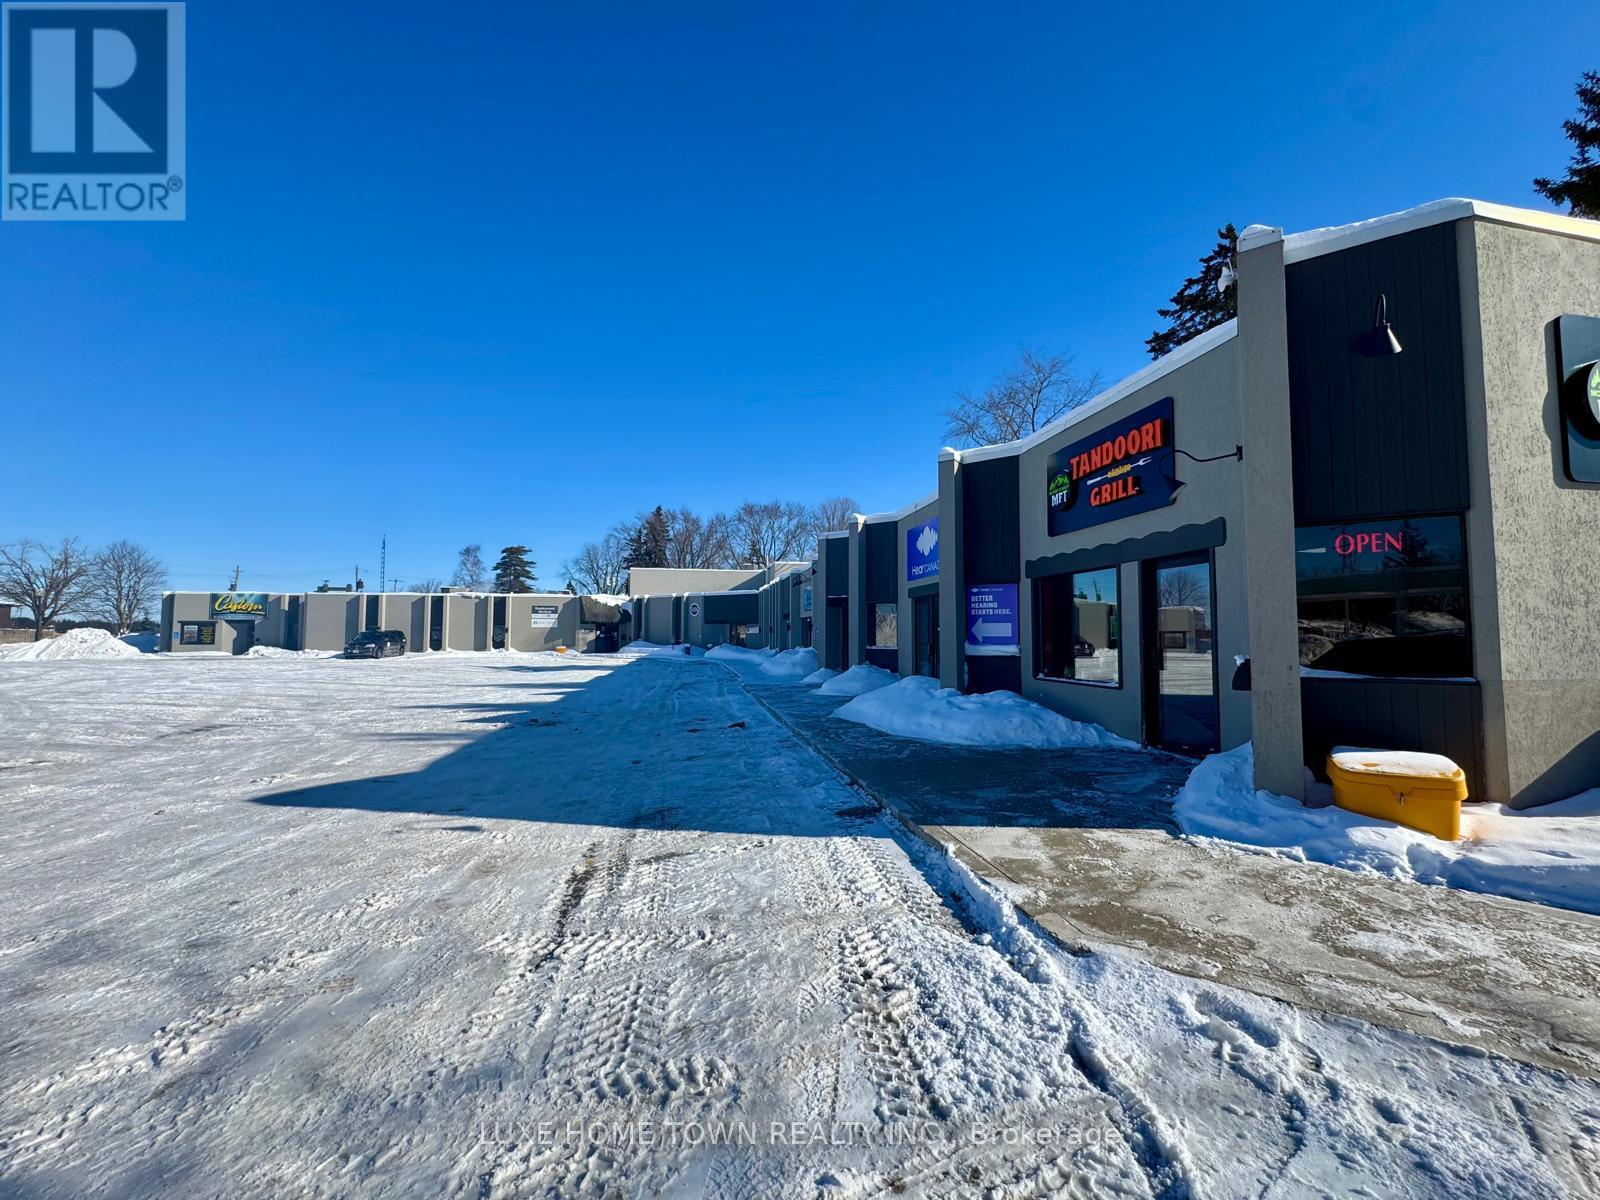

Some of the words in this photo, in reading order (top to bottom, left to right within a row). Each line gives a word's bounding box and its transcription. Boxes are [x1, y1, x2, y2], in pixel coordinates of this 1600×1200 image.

[1069, 418, 1164, 480] TANDOORI
[1051, 489, 1068, 507] MFT
[1089, 475, 1137, 507] GRILL
[1334, 531, 1403, 554] OPEN
[214, 594, 263, 613] Custom
